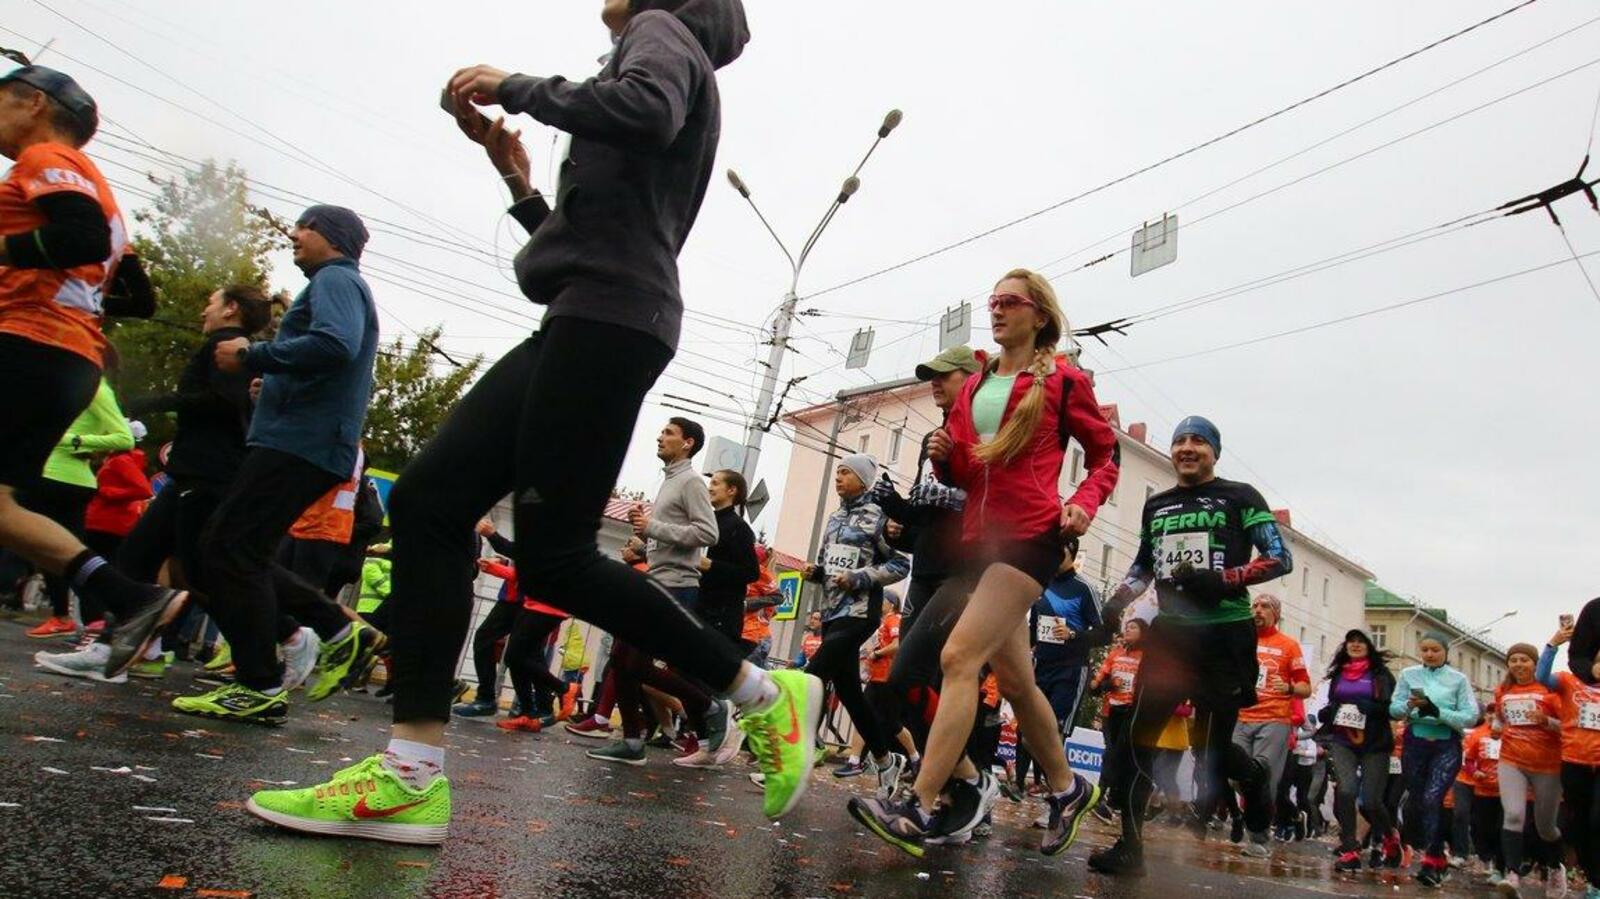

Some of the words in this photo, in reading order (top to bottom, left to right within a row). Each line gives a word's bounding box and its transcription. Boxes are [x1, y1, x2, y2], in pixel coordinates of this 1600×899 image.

[1151, 511, 1226, 532] PERM
[829, 556, 855, 569] 4452
[1166, 549, 1204, 565] 4423
